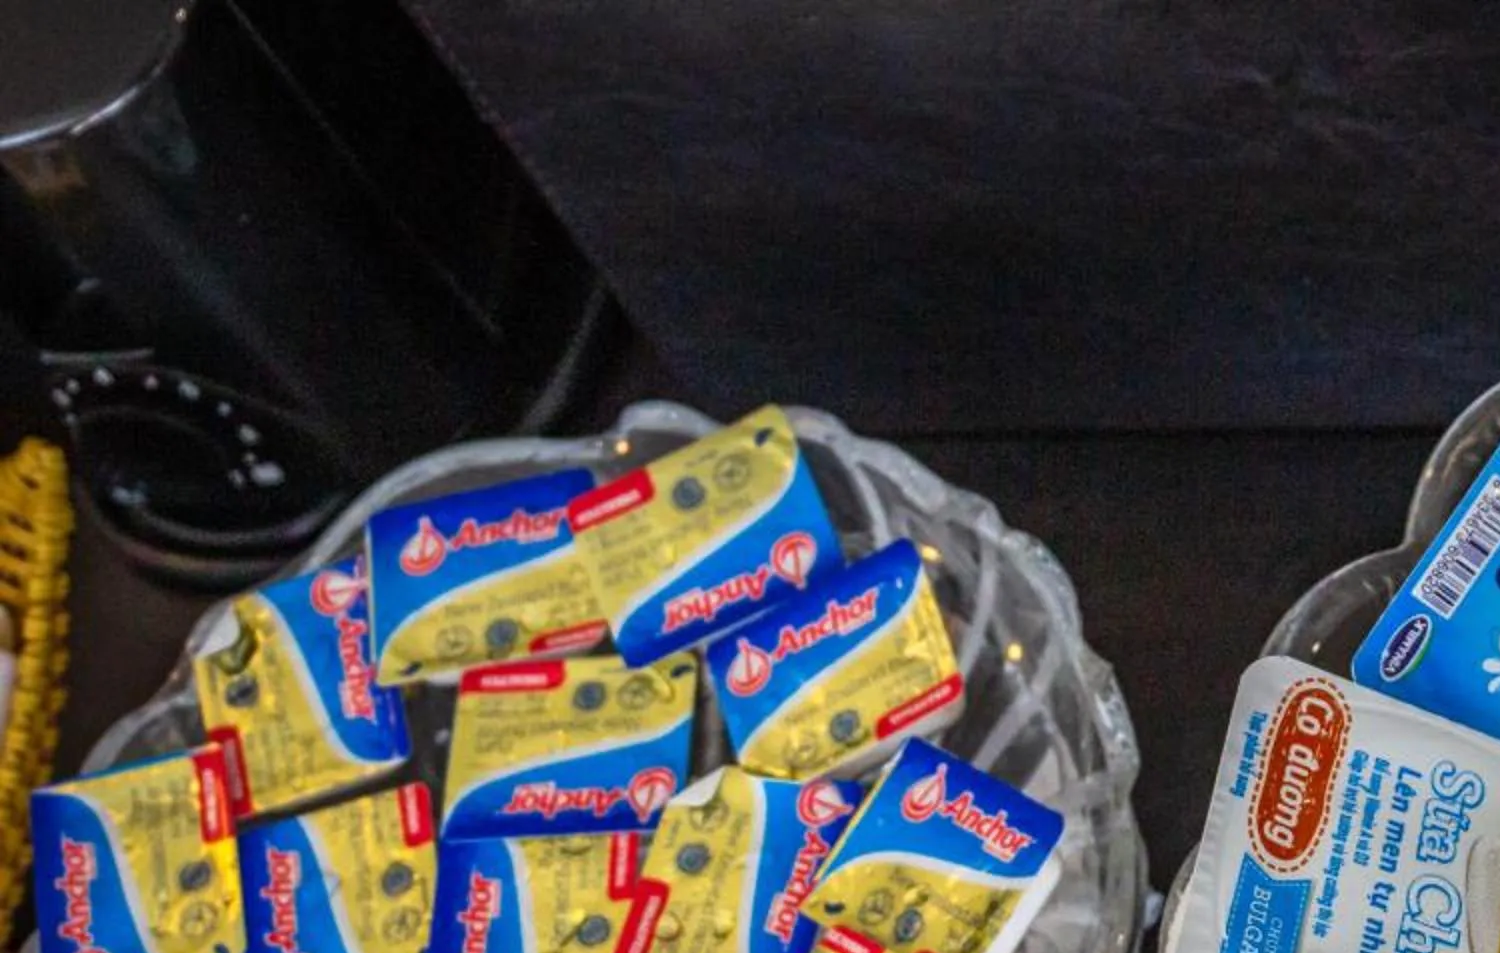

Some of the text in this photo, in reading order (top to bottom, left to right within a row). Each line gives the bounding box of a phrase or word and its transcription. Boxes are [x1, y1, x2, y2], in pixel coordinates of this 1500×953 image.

[451, 507, 570, 549] Anchor
[664, 565, 772, 630] Anchor
[771, 589, 877, 658] Anchor
[336, 615, 376, 722] Anchor
[1380, 616, 1428, 675] VINAMILK
[504, 785, 617, 816] Anchor
[1267, 695, 1335, 847] Có đường
[1393, 767, 1422, 814] Lên
[939, 787, 1031, 862] Anchor
[1416, 760, 1486, 865] Sữa
[1379, 821, 1405, 872] men
[59, 841, 93, 943] Anchor
[266, 849, 298, 949] Anchor
[1365, 880, 1395, 911] tự
